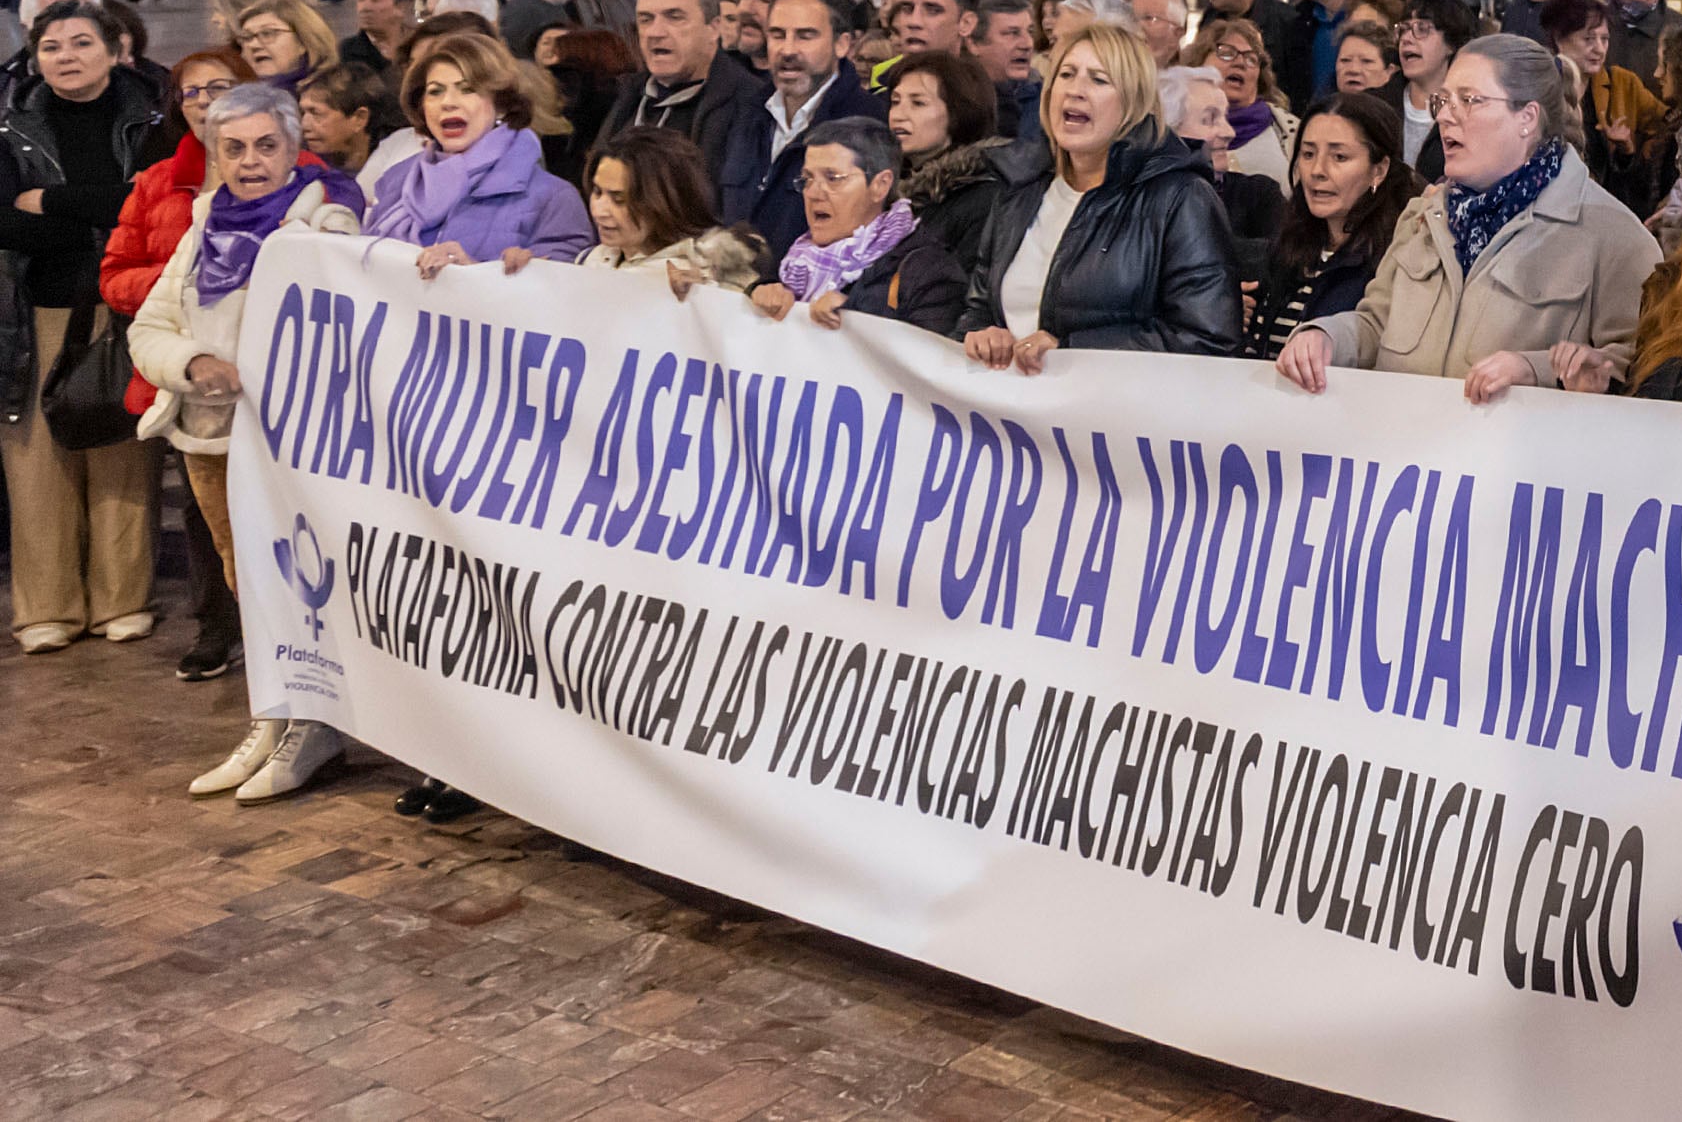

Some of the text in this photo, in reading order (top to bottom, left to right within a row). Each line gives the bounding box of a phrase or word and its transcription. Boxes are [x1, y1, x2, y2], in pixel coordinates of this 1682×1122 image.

[260, 283, 387, 484] OTRA
[387, 311, 585, 529] MUJER
[561, 349, 903, 600] ASESINADA
[897, 402, 1043, 629] POR
[1036, 427, 1122, 648] LA
[1131, 437, 1474, 727] VIOLENCIA
[275, 644, 344, 676] Plataforma
[347, 522, 1643, 1008] PLATAFORMA CONTRA LAS VIOLENCIAS MACHISTAS VIOLENCIA CERO
